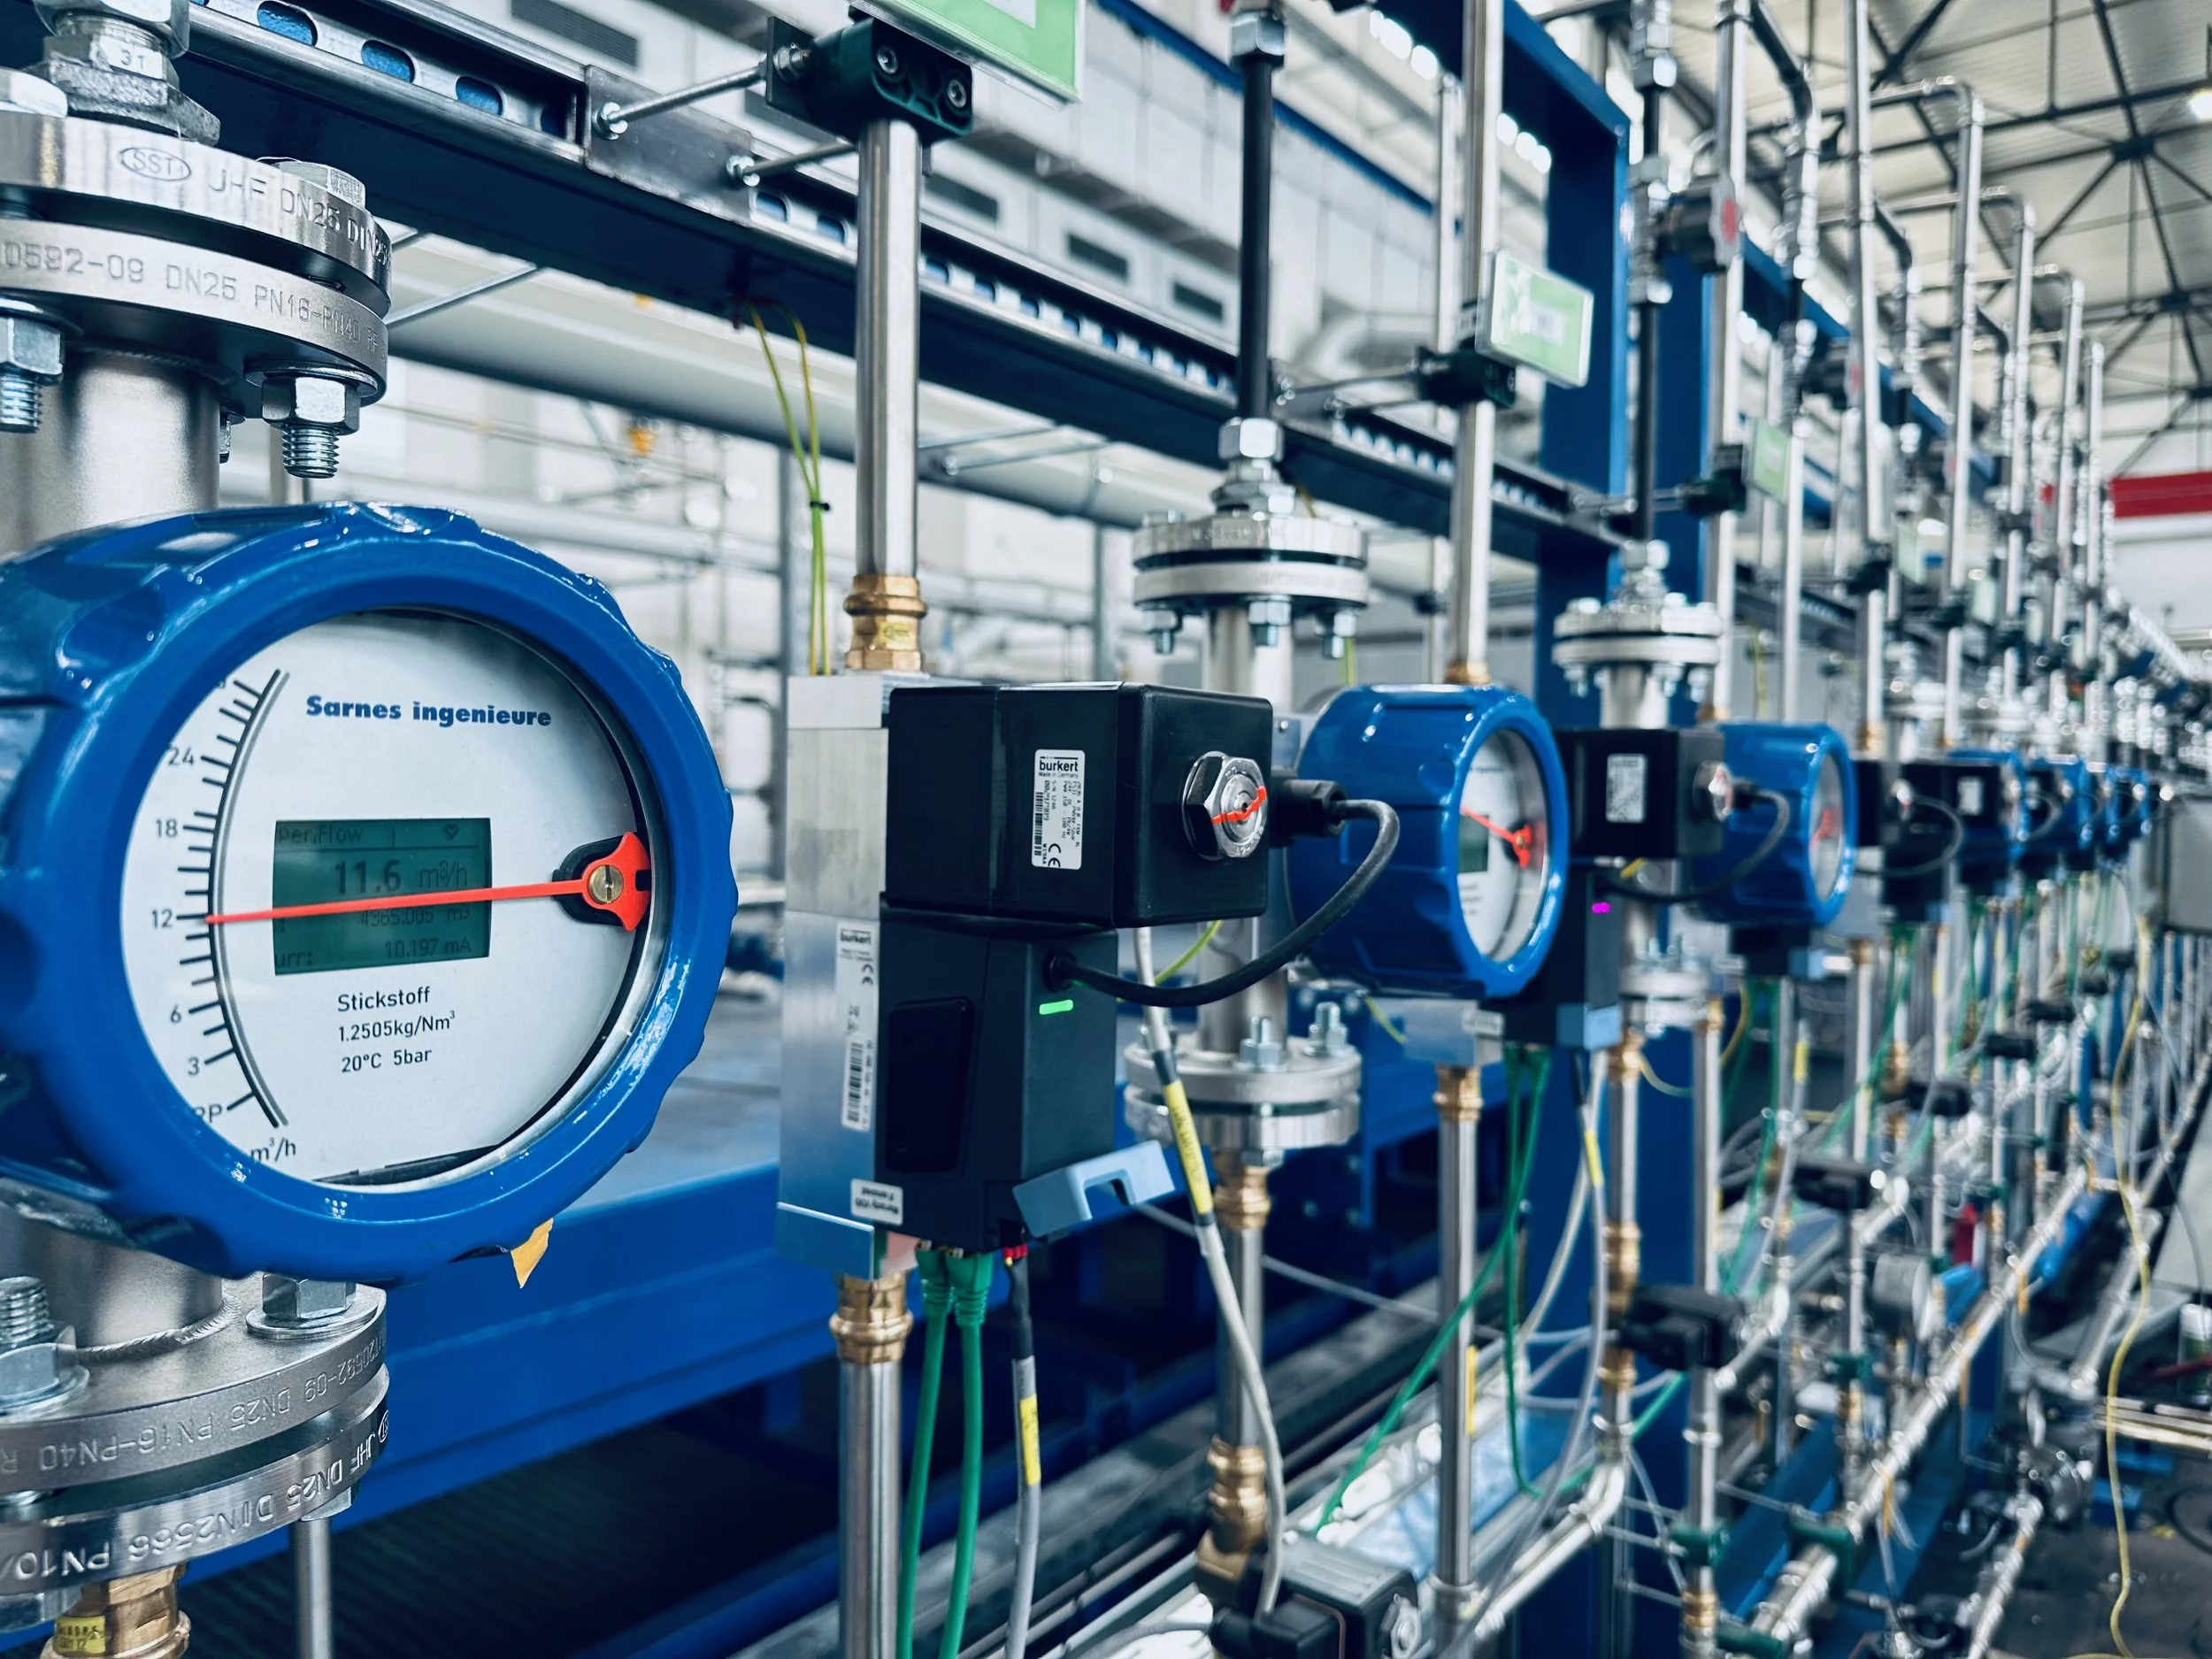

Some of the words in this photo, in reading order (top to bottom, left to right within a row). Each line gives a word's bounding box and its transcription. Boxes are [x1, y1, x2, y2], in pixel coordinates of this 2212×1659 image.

[209, 169, 267, 202] JHF
[280, 188, 341, 232] DN25
[165, 264, 238, 301] DN25
[253, 284, 361, 343] PN16-PN40
[306, 695, 402, 719] Sarnes
[412, 702, 552, 727] ingenieure
[168, 744, 196, 766] 24
[155, 818, 178, 838] 18
[334, 860, 402, 895] 11.6
[151, 908, 173, 928] 12
[385, 938, 440, 960] 10.197
[445, 937, 472, 954] mA
[169, 1004, 182, 1024] 6
[337, 985, 430, 1012] Stickstoff
[338, 1010, 456, 1042] 1.2505kg/Nm³
[187, 1056, 200, 1076] 3
[342, 1052, 382, 1073] 20°C
[393, 1048, 433, 1066] 5bar
[230, 1386, 290, 1432] DN25
[40, 1412, 214, 1471] PN16-PN40
[349, 1432, 376, 1475] JHF
[286, 1459, 343, 1512] DN25
[127, 1495, 273, 1563] DIN2566
